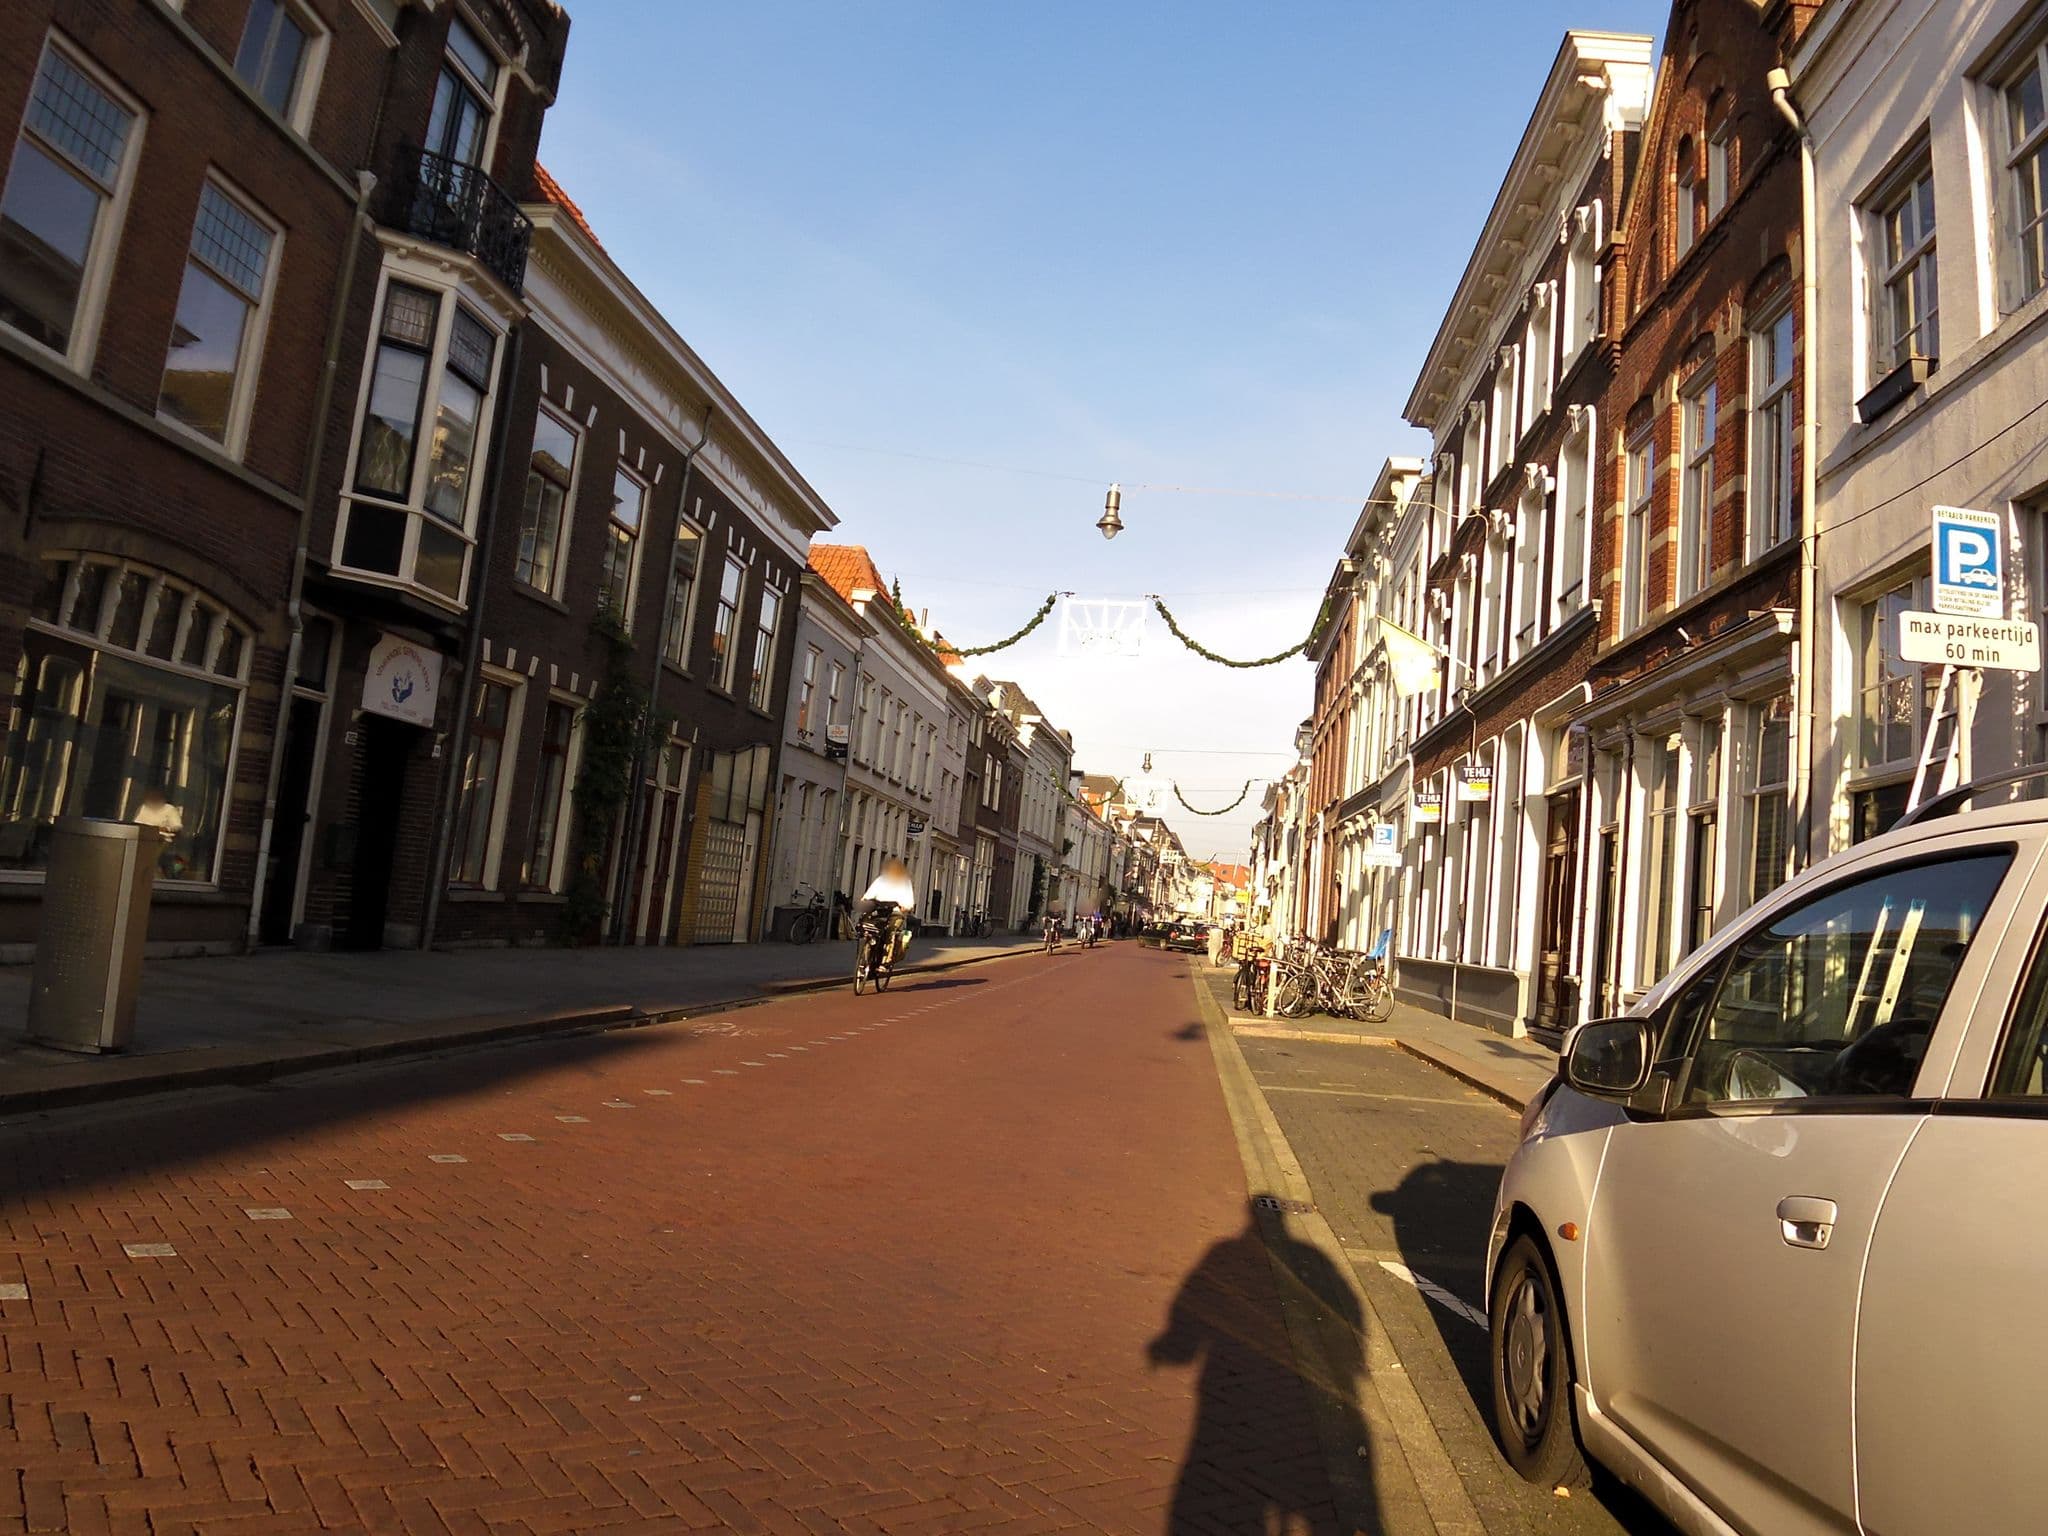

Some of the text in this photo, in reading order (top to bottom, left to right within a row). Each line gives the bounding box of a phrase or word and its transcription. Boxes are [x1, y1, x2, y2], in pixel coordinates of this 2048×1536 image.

[1910, 620, 2032, 647] max parkeertijd
[1946, 643, 2000, 662] 60 min
[1463, 767, 1492, 778] TE HU
